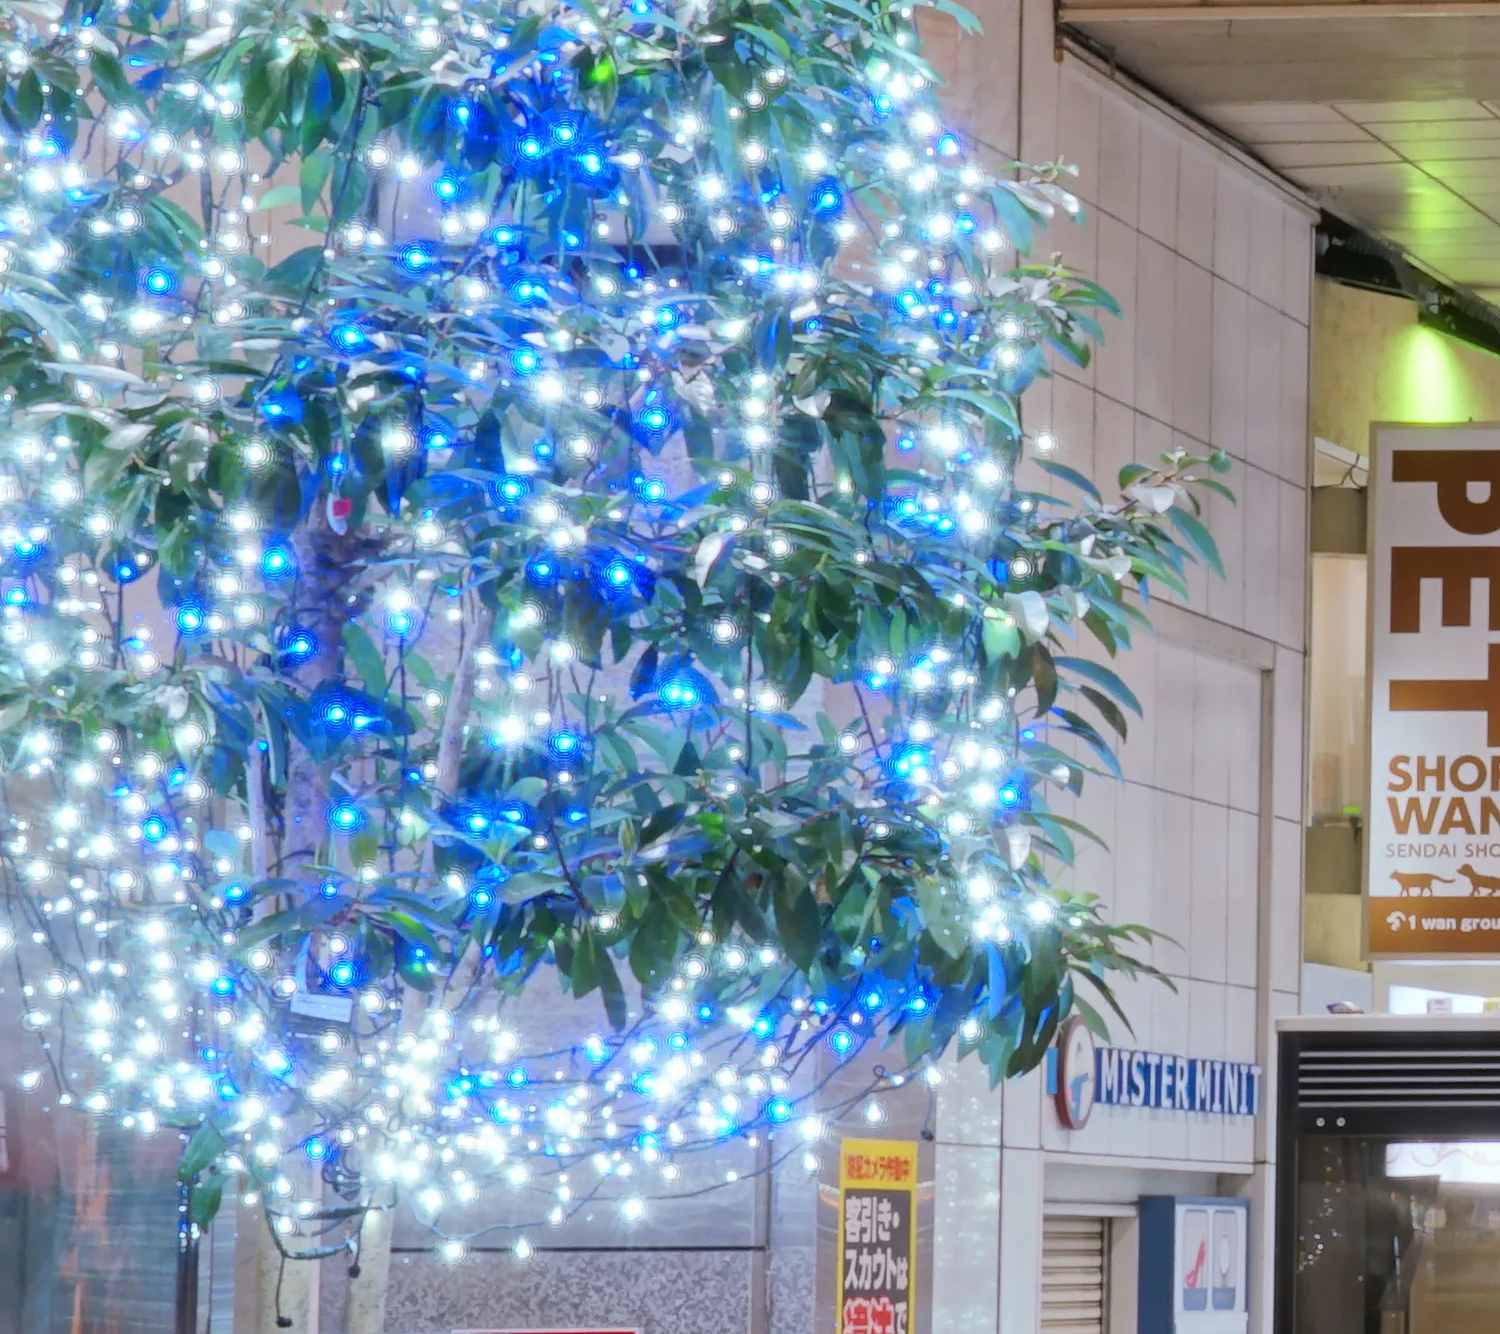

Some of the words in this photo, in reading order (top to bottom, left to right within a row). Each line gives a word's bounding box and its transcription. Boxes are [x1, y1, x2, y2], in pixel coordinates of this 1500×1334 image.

[1386, 843, 1457, 858] SENDAI
[1421, 917, 1456, 930] wan
[1101, 1048, 1190, 1111] MISTER
[1195, 1059, 1262, 1115] MINIT
[844, 1247, 909, 1292] スカウトは
